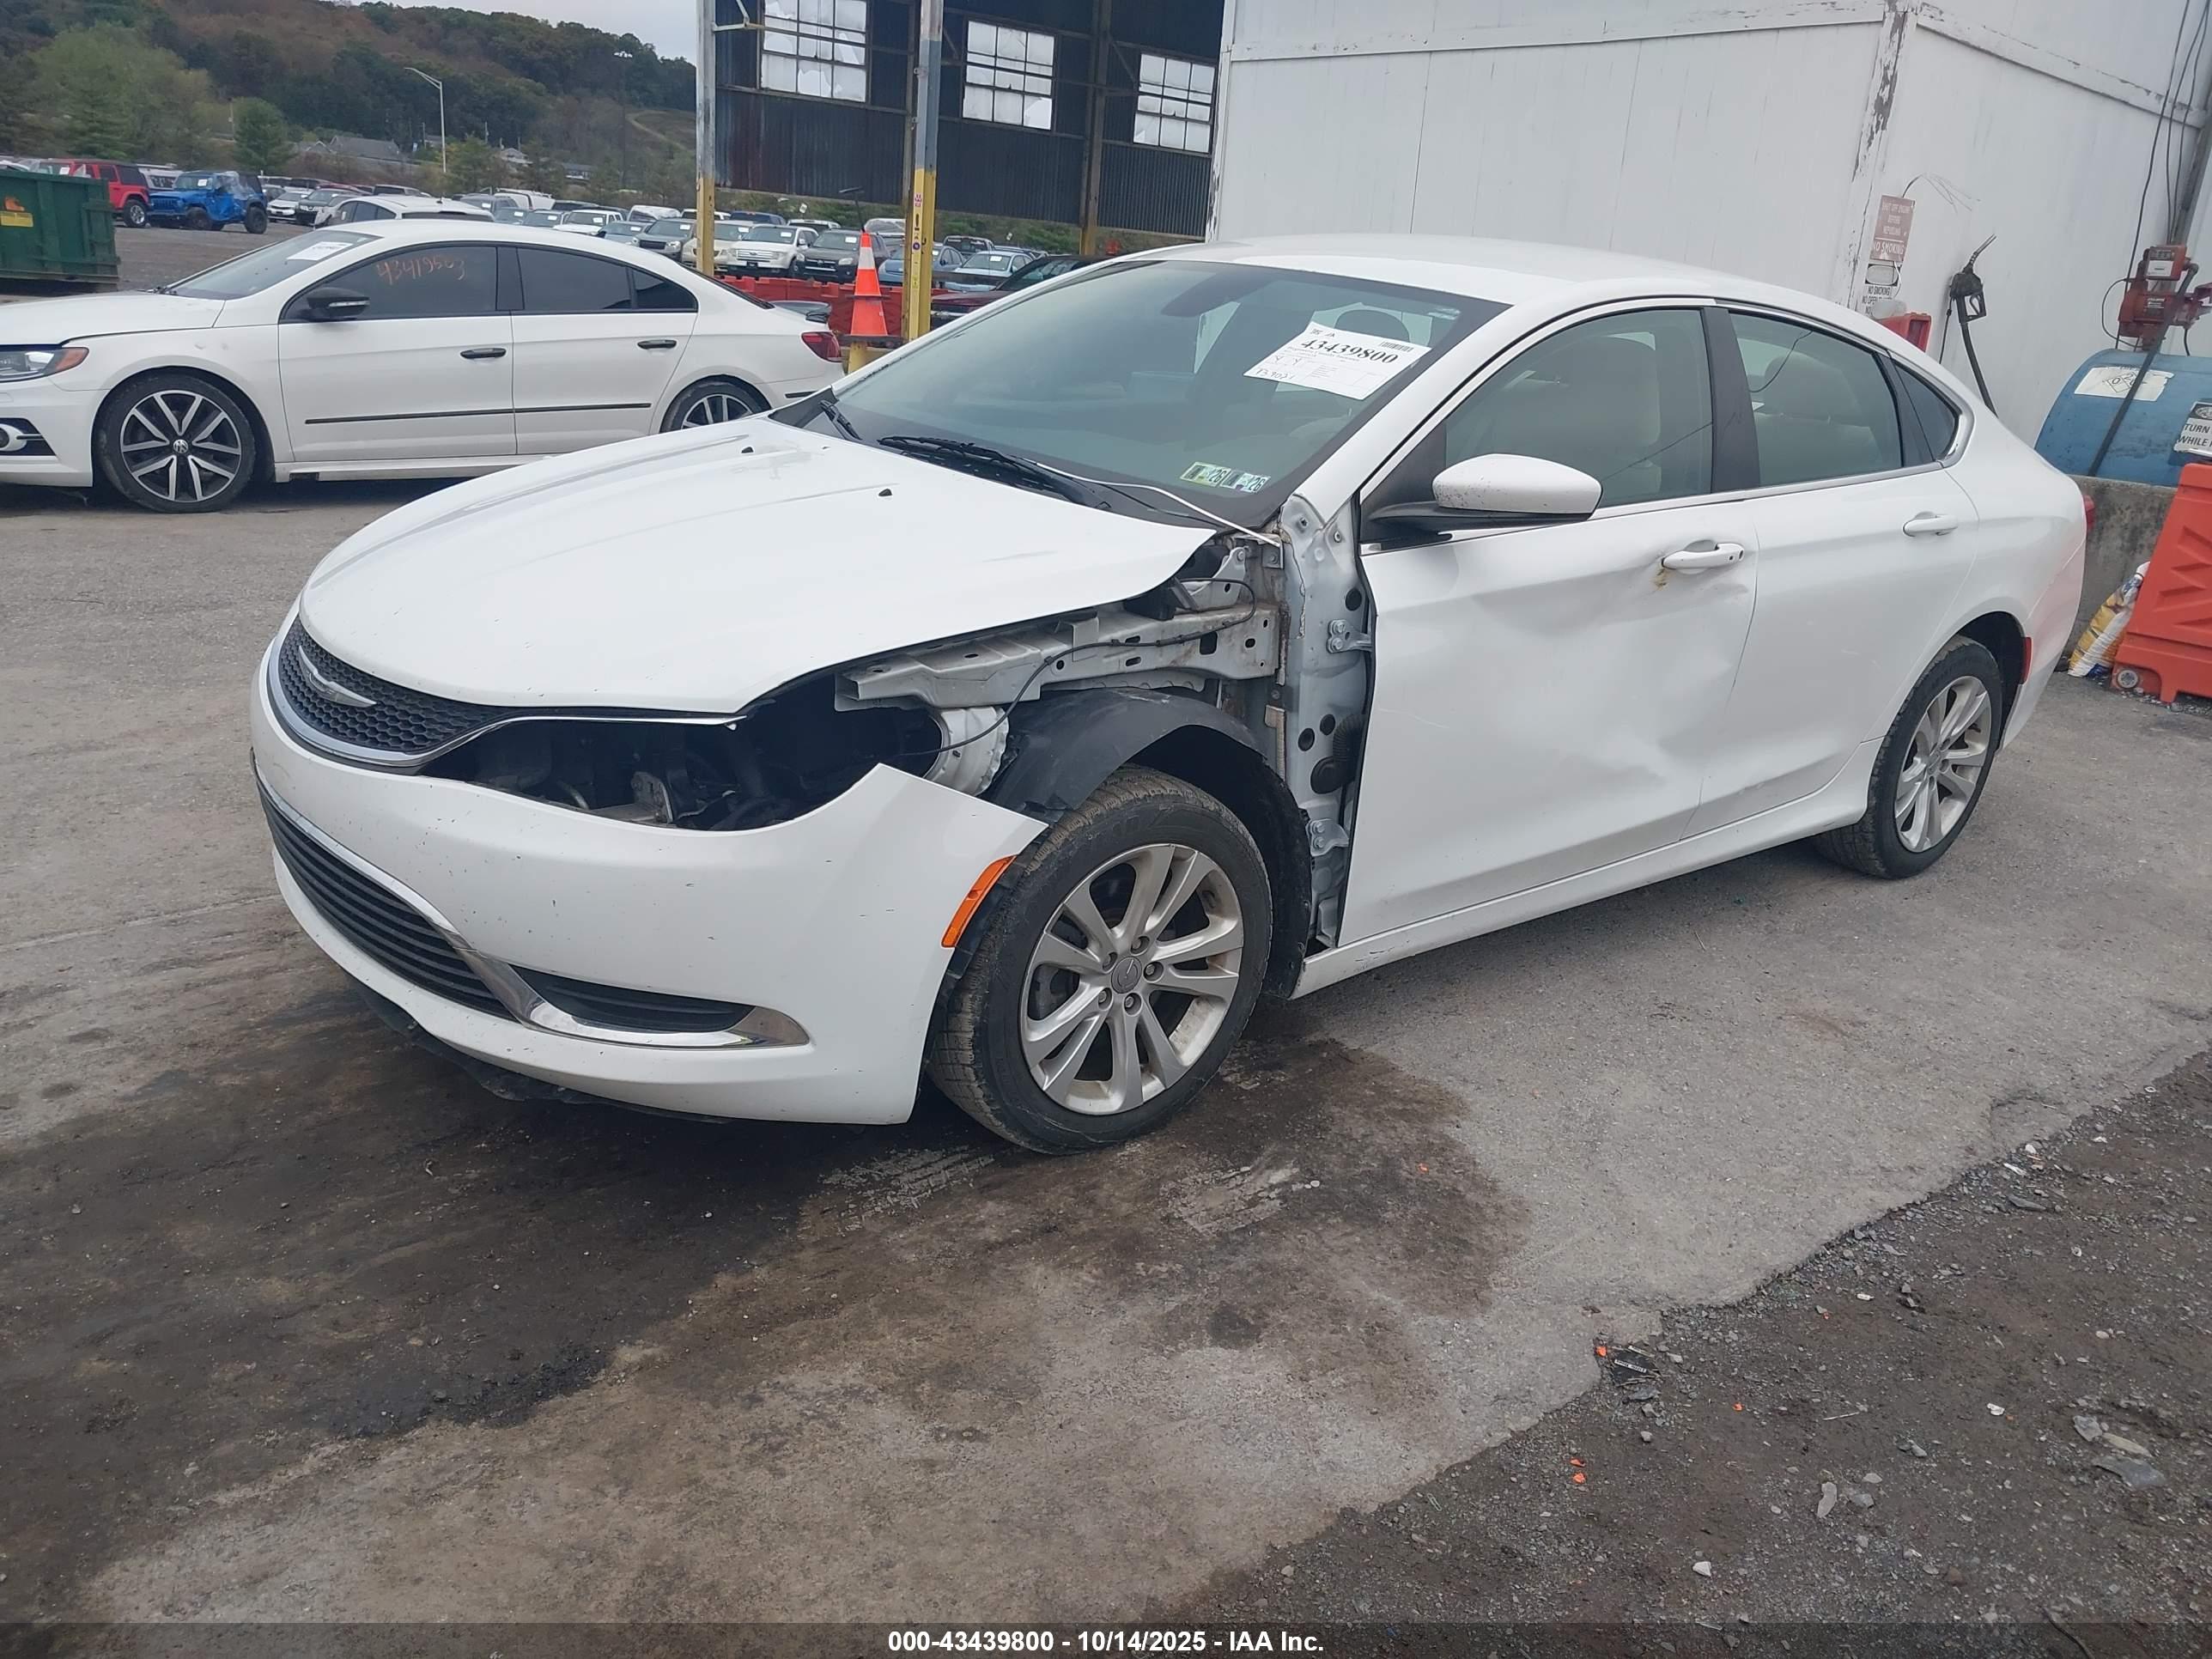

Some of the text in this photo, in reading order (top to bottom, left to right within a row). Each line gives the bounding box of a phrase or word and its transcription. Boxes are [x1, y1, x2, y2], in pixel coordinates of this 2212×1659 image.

[1881, 241, 1905, 255] SMOKING
[1874, 286, 1891, 295] SMOKING
[1300, 338, 1399, 364] 43439800
[2185, 423, 2210, 433] TURN
[2179, 435, 2209, 447] WHILE
